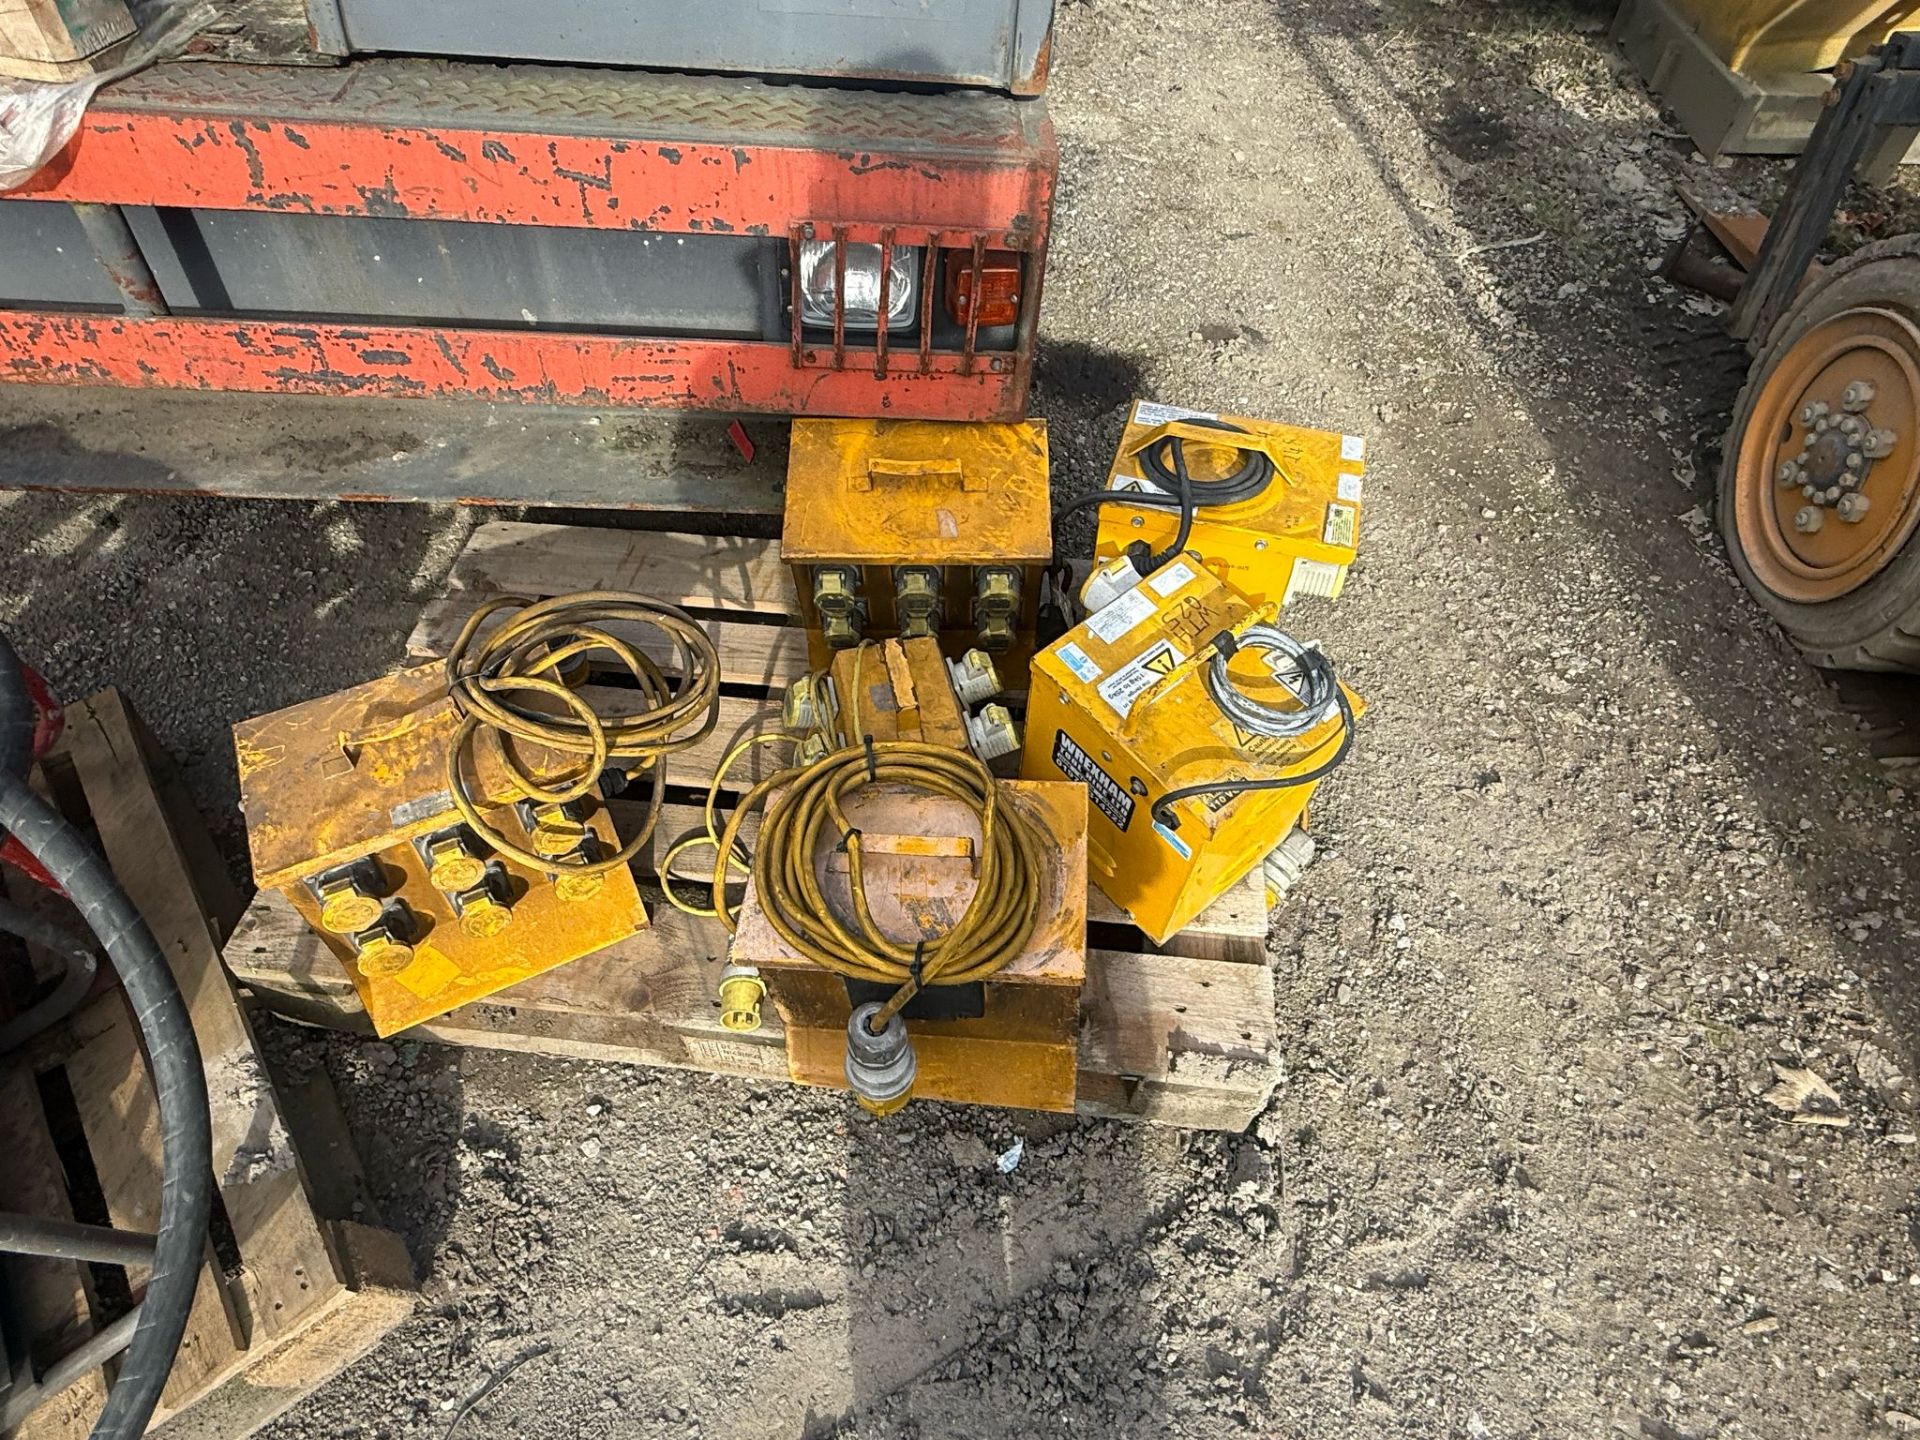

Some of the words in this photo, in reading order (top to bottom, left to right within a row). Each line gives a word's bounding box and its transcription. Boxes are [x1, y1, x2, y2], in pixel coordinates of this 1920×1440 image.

[1173, 606, 1219, 644] WTH
[1122, 682, 1131, 690] to
[1128, 672, 1145, 686] 15kg
[1106, 687, 1124, 700] 25kg
[1247, 733, 1271, 752] Cauti
[1059, 732, 1133, 811] WREXHAM
[1059, 746, 1082, 772] TOOL
[1110, 797, 1128, 817] LTD
[1208, 794, 1226, 810] 110
